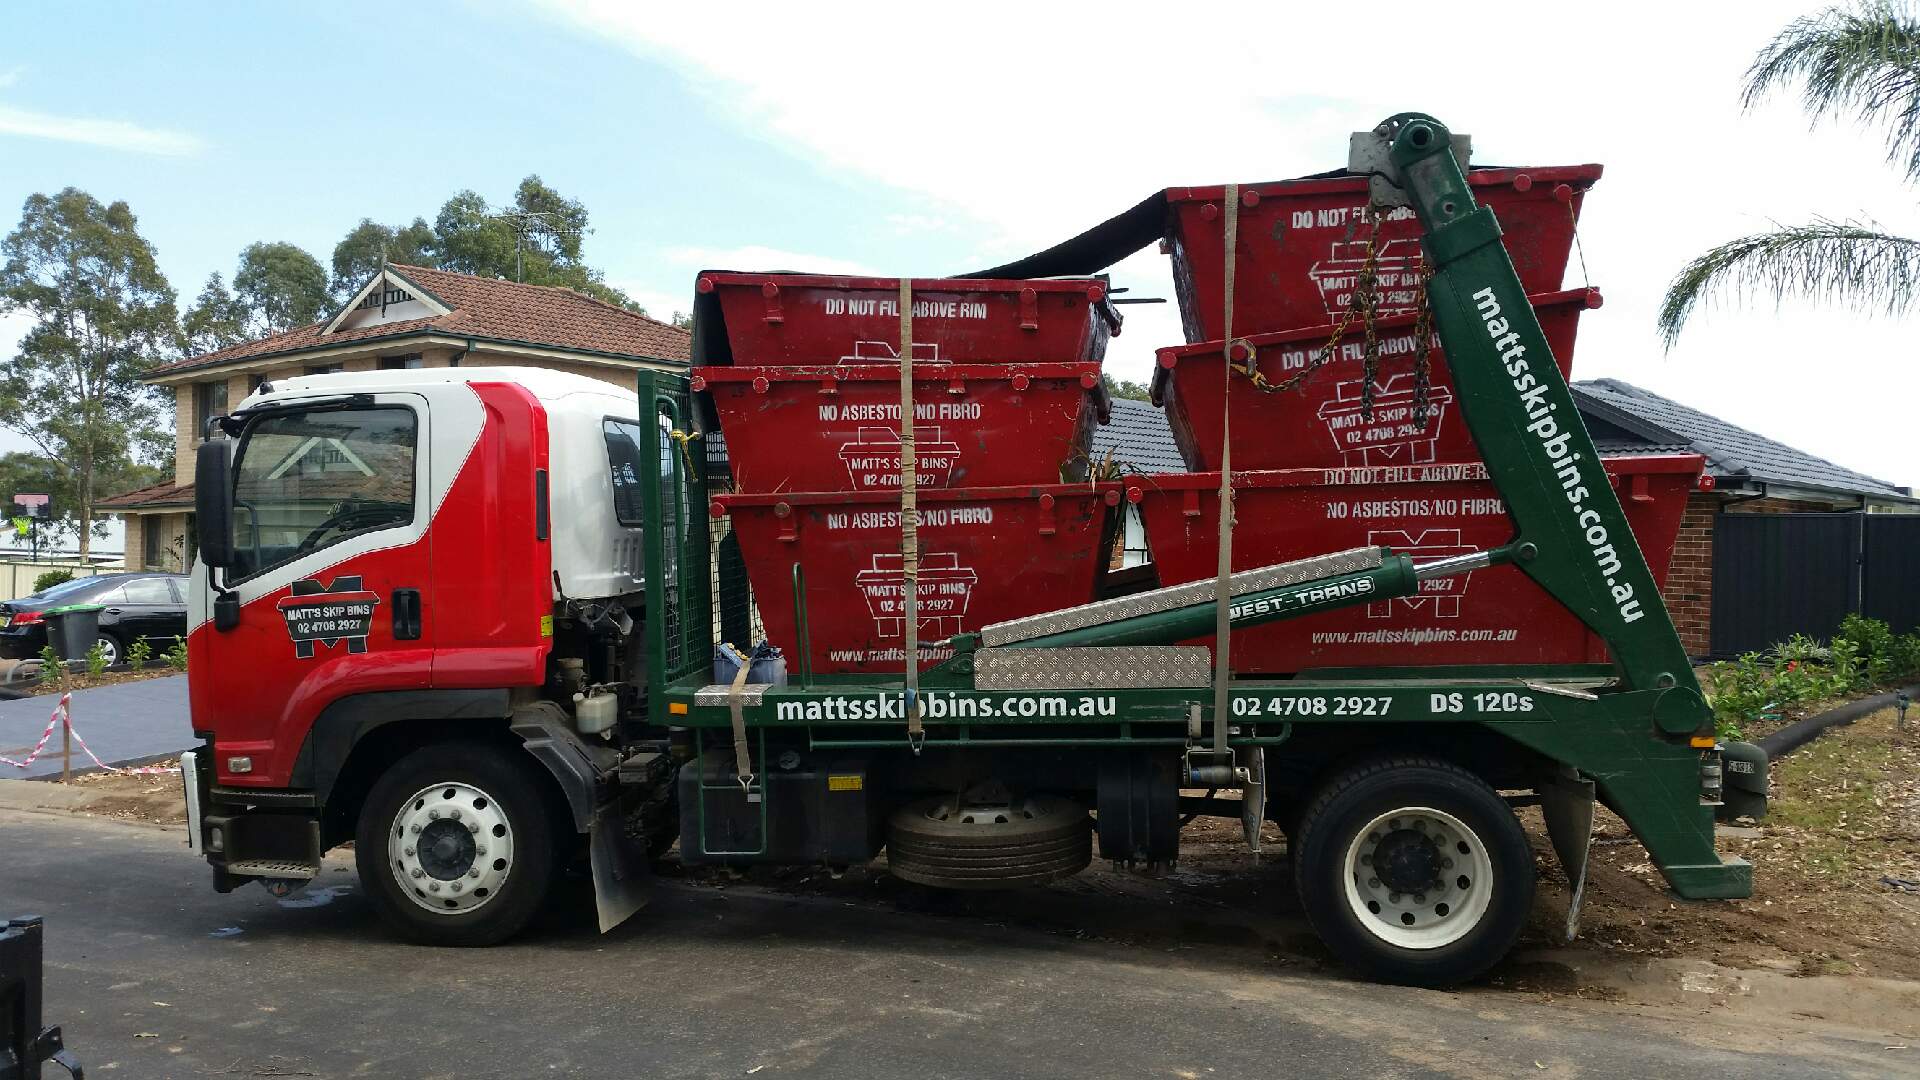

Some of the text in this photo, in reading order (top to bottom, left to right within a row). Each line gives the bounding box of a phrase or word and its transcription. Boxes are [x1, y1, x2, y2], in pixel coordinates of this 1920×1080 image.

[1291, 211, 1314, 228] DO
[1317, 208, 1348, 227] NOT
[1336, 293, 1352, 306] 02
[826, 298, 987, 320] DO NOT FIL ABOVE RIM
[1281, 351, 1305, 370] DO
[1377, 335, 1417, 357] ABOV
[819, 403, 981, 421] NO ASBESTO/NO FIBRO
[1379, 407, 1408, 423] SKIP
[1346, 432, 1362, 444] 02
[1365, 427, 1395, 442] 4708
[851, 457, 891, 470] MATT'S
[921, 457, 948, 469] BINS
[1472, 286, 1645, 624] mattsskipbins.com.au
[863, 474, 877, 486] 02
[1324, 469, 1345, 485] DO
[1420, 464, 1472, 482] ABOVE
[828, 506, 993, 529] NO ASBESTS/NO FIBRO
[1327, 501, 1347, 519] NO
[1352, 499, 1457, 518] ASBESTOS/NO
[917, 584, 936, 597] KIP
[939, 582, 967, 595] BINS
[1424, 578, 1454, 592] 2927
[287, 604, 370, 621] MATT'S SKIP BINS
[880, 600, 894, 612] 02
[927, 599, 954, 611] 2927
[297, 619, 361, 634] 02 4708 2927
[1311, 627, 1518, 646] www.mattsskipbins.com.au
[1232, 696, 1393, 716] 02 4708 2927
[1430, 693, 1464, 713] DS
